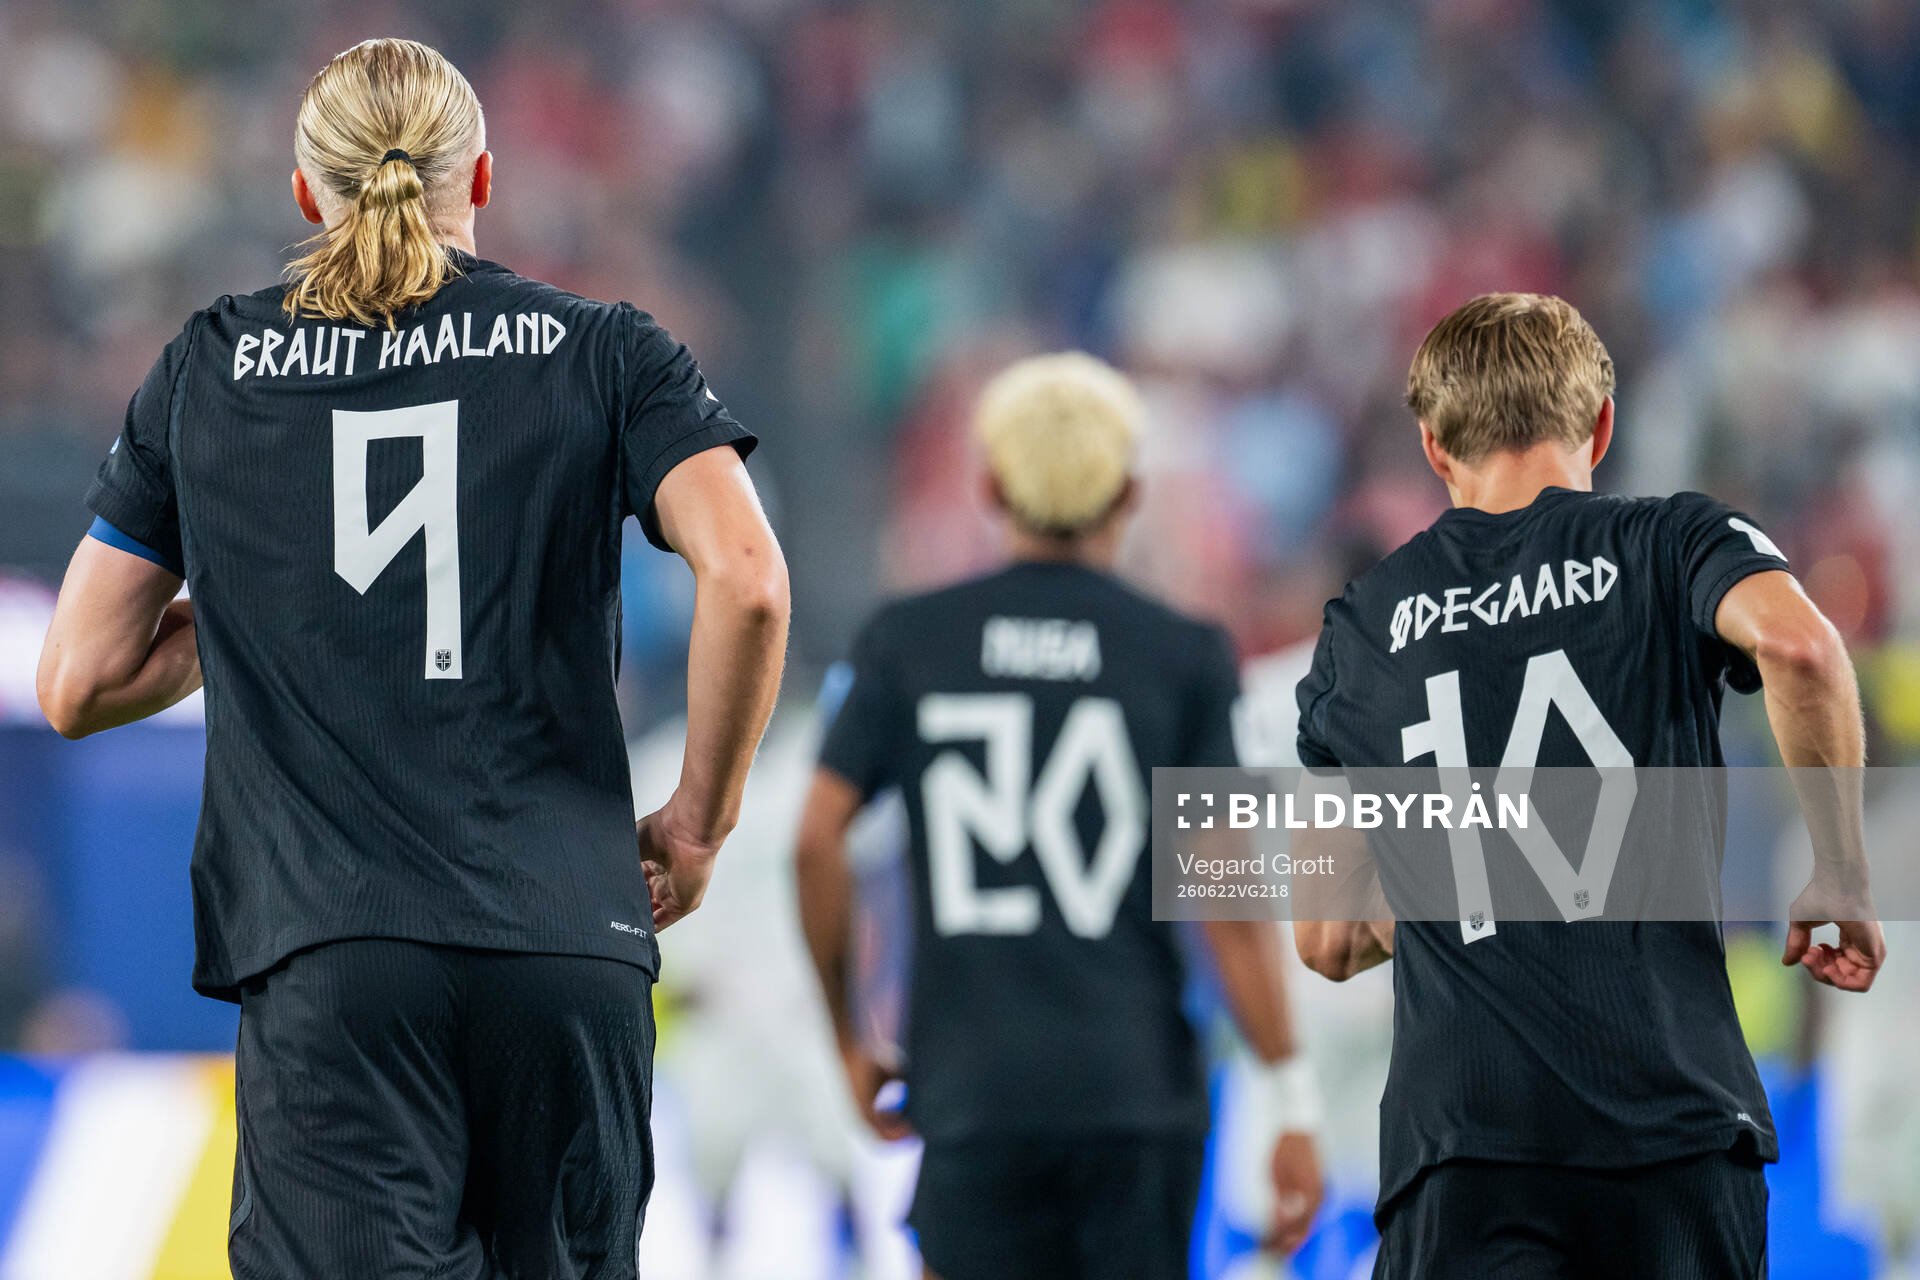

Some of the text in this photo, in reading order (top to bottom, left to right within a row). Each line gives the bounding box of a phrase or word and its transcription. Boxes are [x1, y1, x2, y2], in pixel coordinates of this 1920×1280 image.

[233, 311, 567, 381] BRAUT HAALAND
[331, 398, 463, 681] 9
[1389, 556, 1619, 654] ØDEGAARD
[917, 692, 1150, 940] 20
[1400, 648, 1639, 945] 10
[610, 920, 648, 939] AERO-FIT
